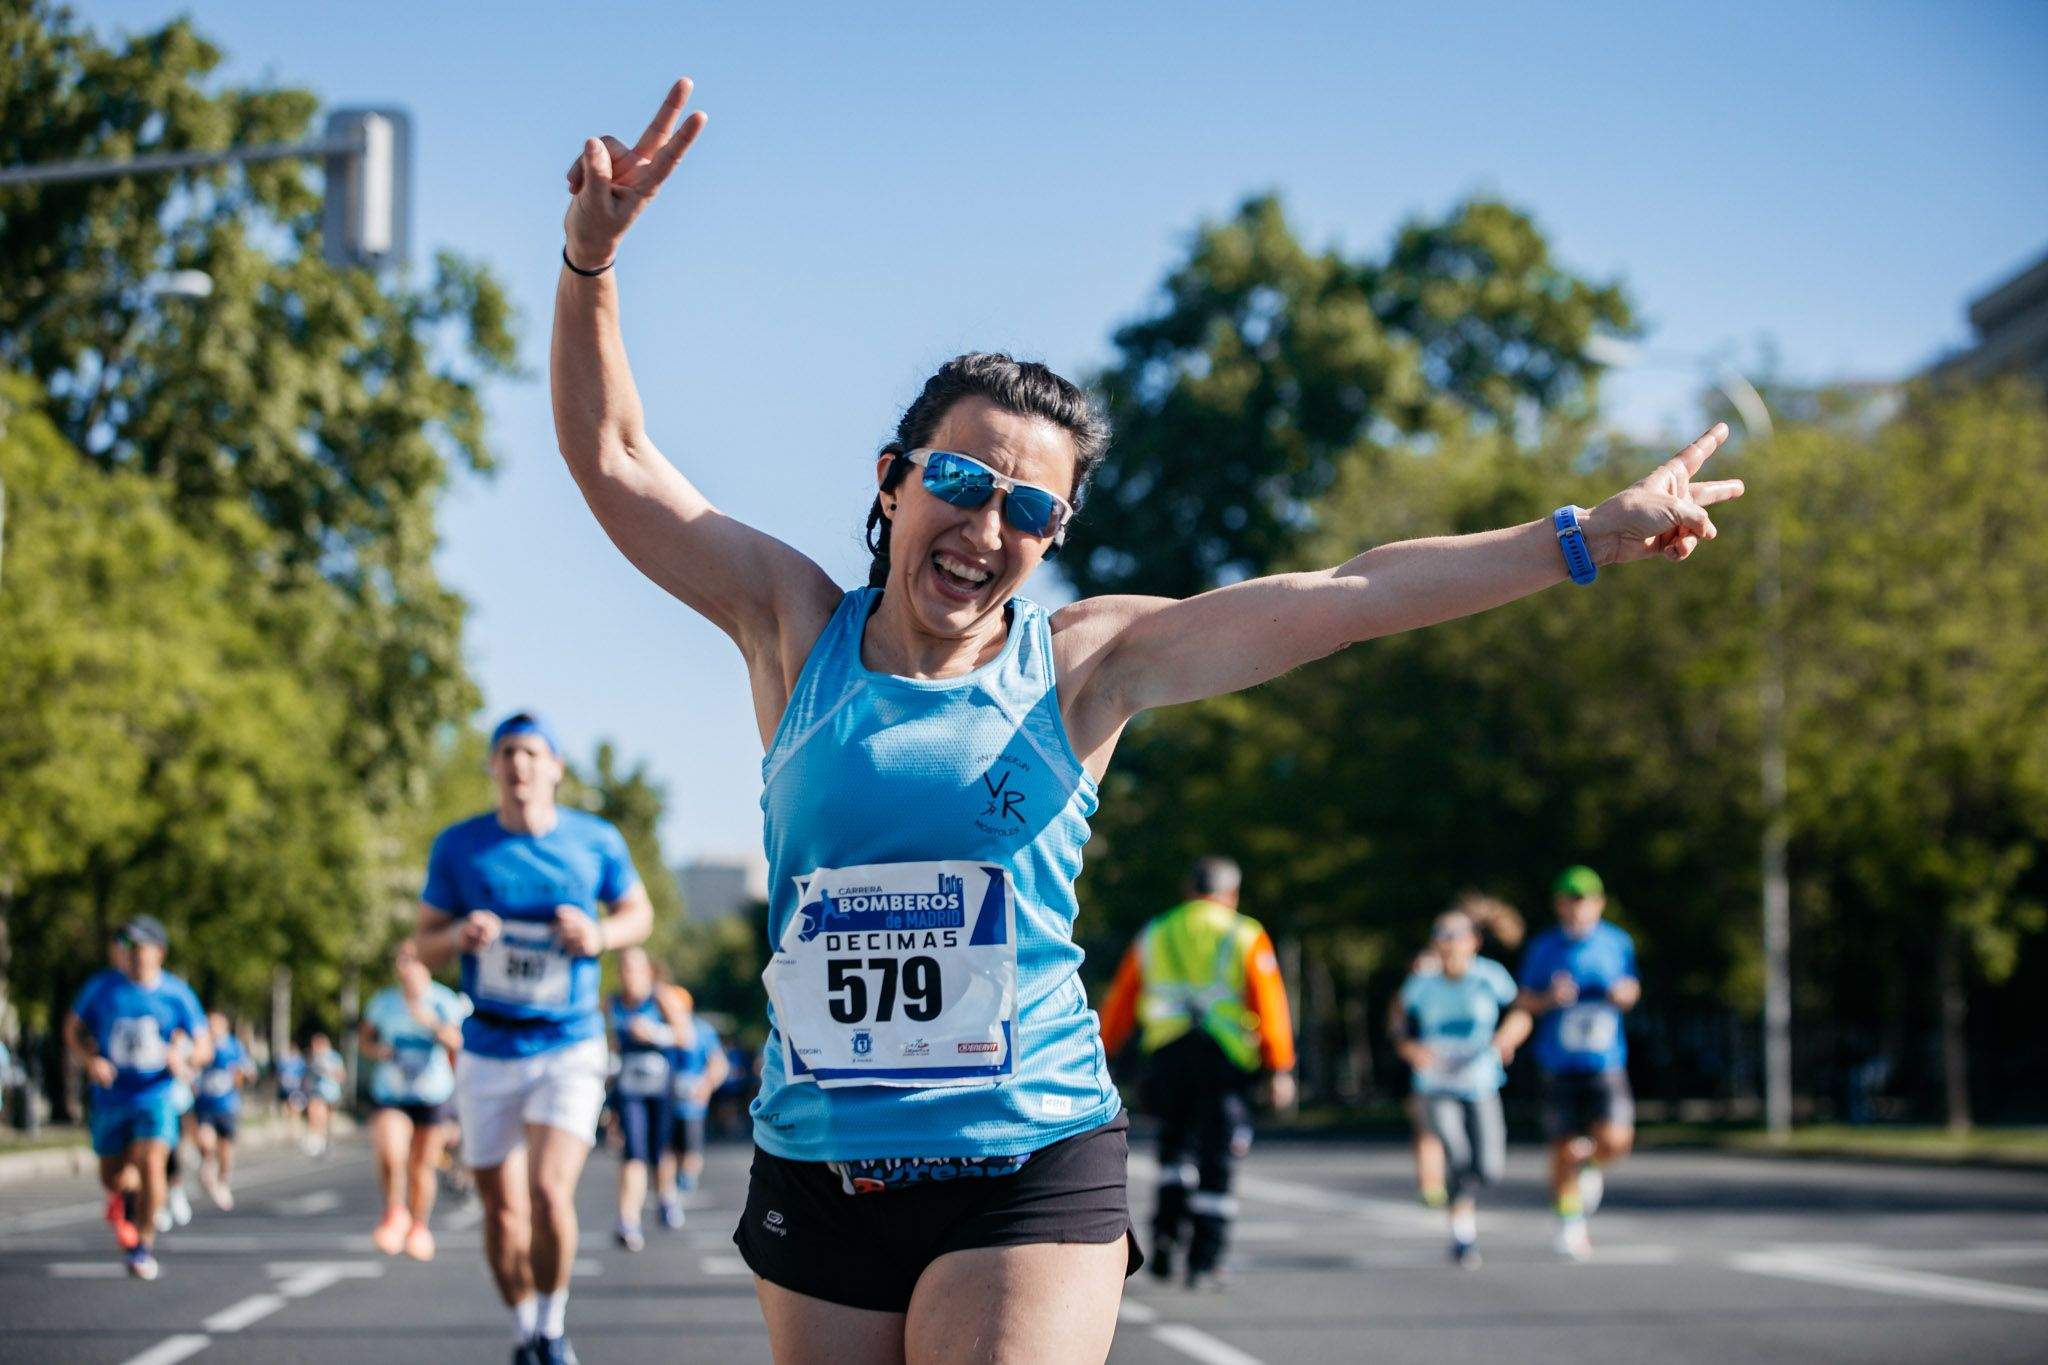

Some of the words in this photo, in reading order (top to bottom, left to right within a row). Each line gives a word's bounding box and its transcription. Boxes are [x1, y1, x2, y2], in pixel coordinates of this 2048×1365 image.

[838, 886, 883, 895] CARRERA
[839, 893, 959, 913] BOMBEROS
[886, 911, 902, 928] de
[906, 910, 960, 928] MADRID
[826, 930, 958, 951] DECIMAS
[827, 956, 943, 1025] 579
